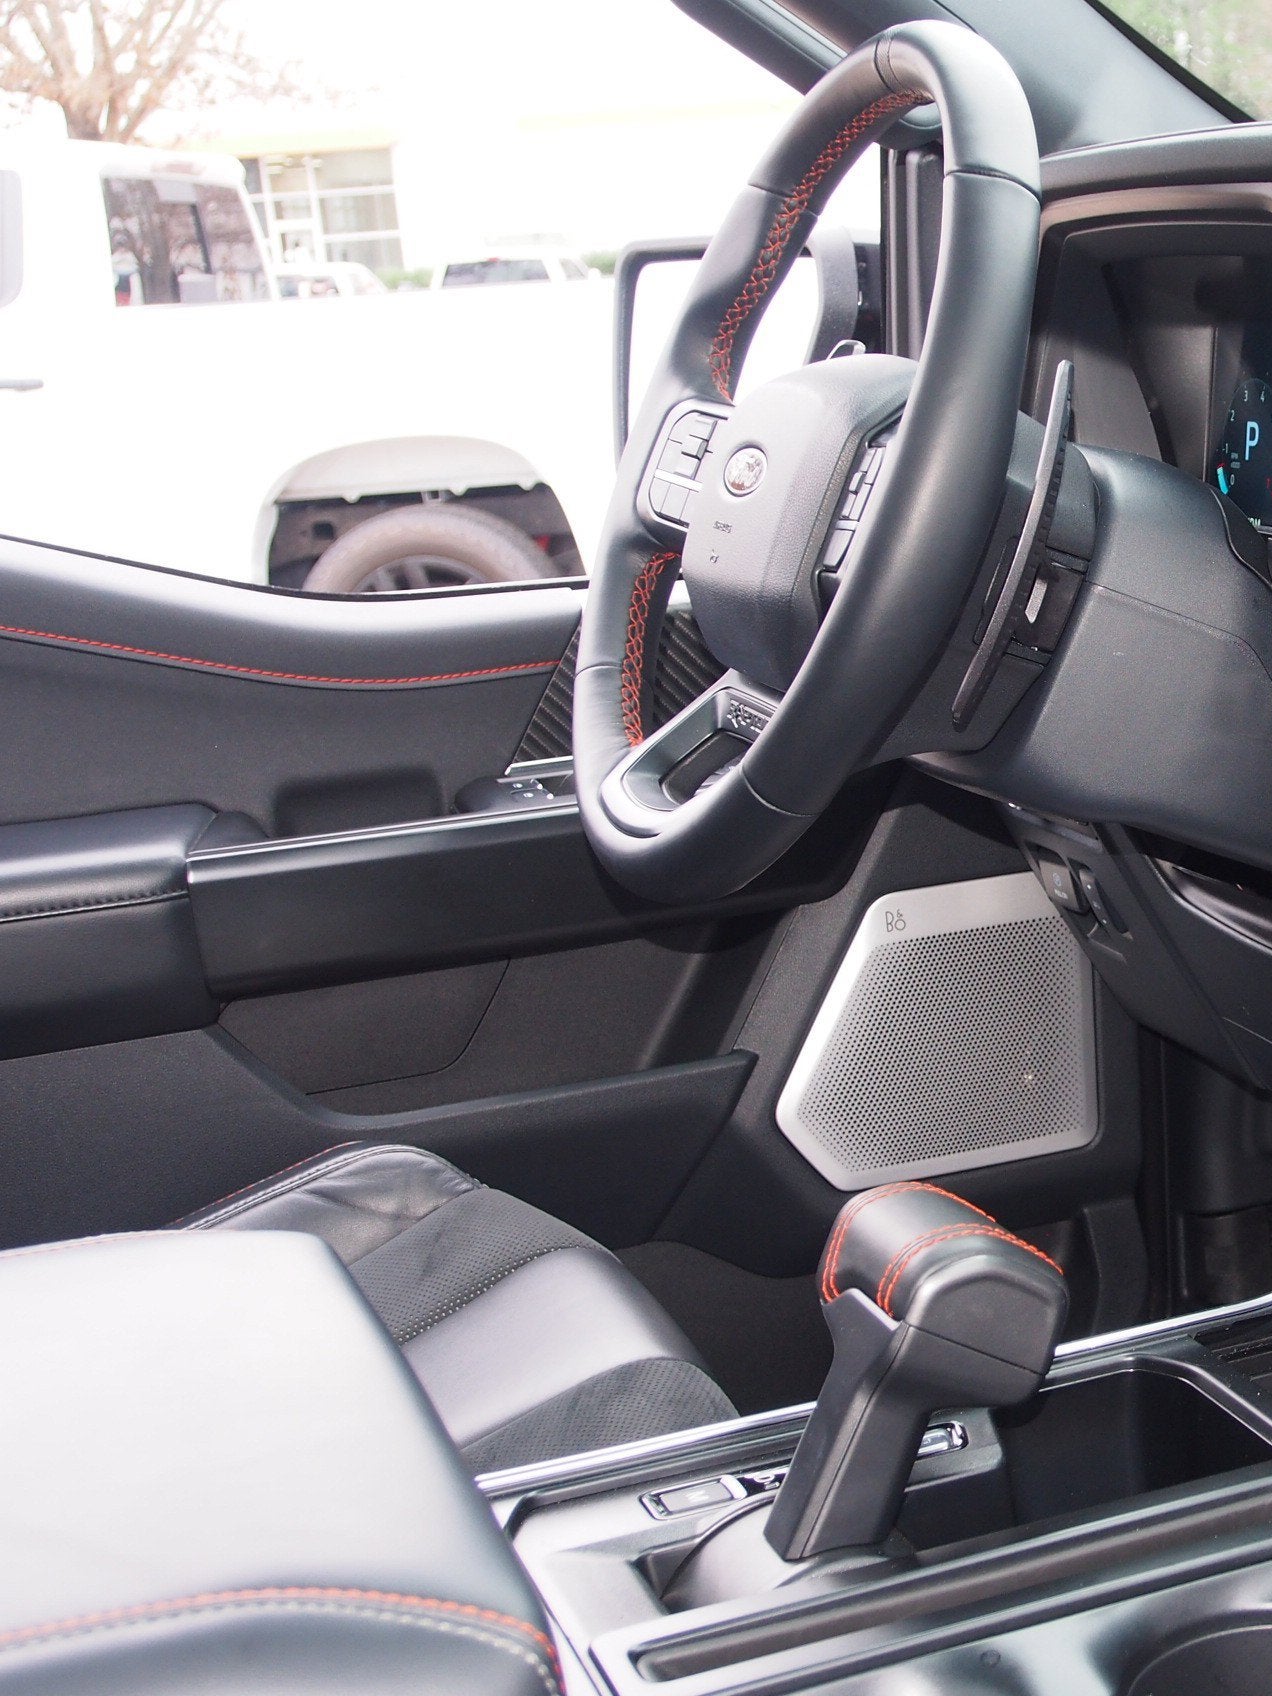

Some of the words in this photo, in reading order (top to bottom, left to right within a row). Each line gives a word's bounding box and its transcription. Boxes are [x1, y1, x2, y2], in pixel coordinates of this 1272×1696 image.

[1243, 390, 1249, 402] 3
[1259, 390, 1265, 402] 4
[1230, 409, 1236, 421] 2
[1244, 420, 1260, 461] P
[1230, 473, 1235, 486] 0
